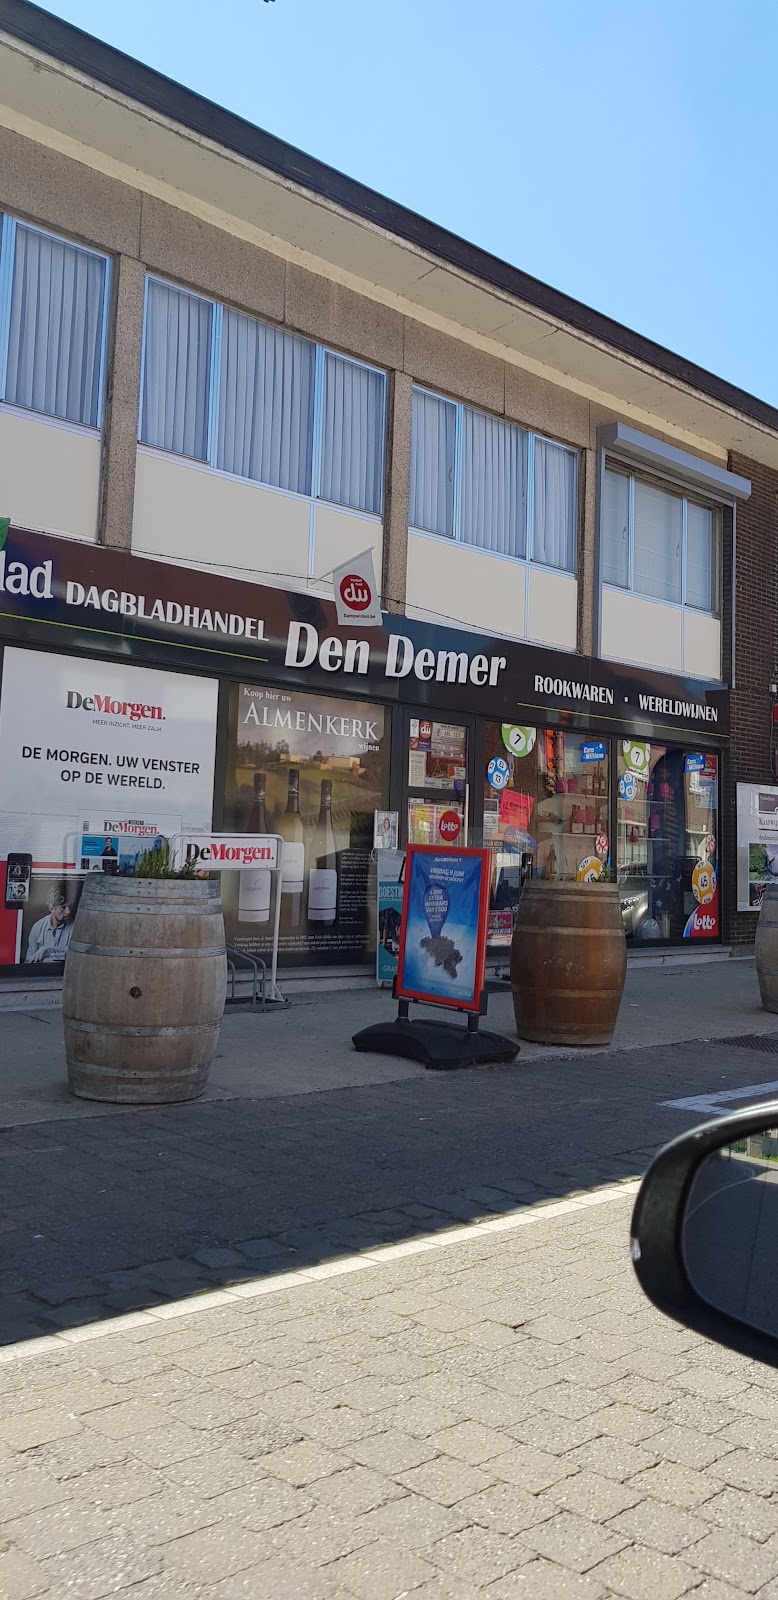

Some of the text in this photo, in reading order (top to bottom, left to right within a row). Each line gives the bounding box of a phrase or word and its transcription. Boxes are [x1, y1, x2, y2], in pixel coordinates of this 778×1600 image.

[66, 580, 270, 642] DAGBLADHANDEL
[284, 620, 508, 687] Den Demer
[243, 687, 293, 702] Koop hier uw
[534, 674, 718, 723] ROOKWAREN WERELDWIJNEN
[66, 690, 167, 722] DeMorgen.
[358, 743, 380, 752] wijnen
[514, 733, 522, 745] 7
[22, 745, 200, 775] DE MORGEN. UW VENSTER
[635, 751, 641, 763] 7
[60, 769, 166, 790] OP DE WERELD.
[103, 821, 160, 836] DeMorgen.
[186, 843, 275, 865] DeMorgen.
